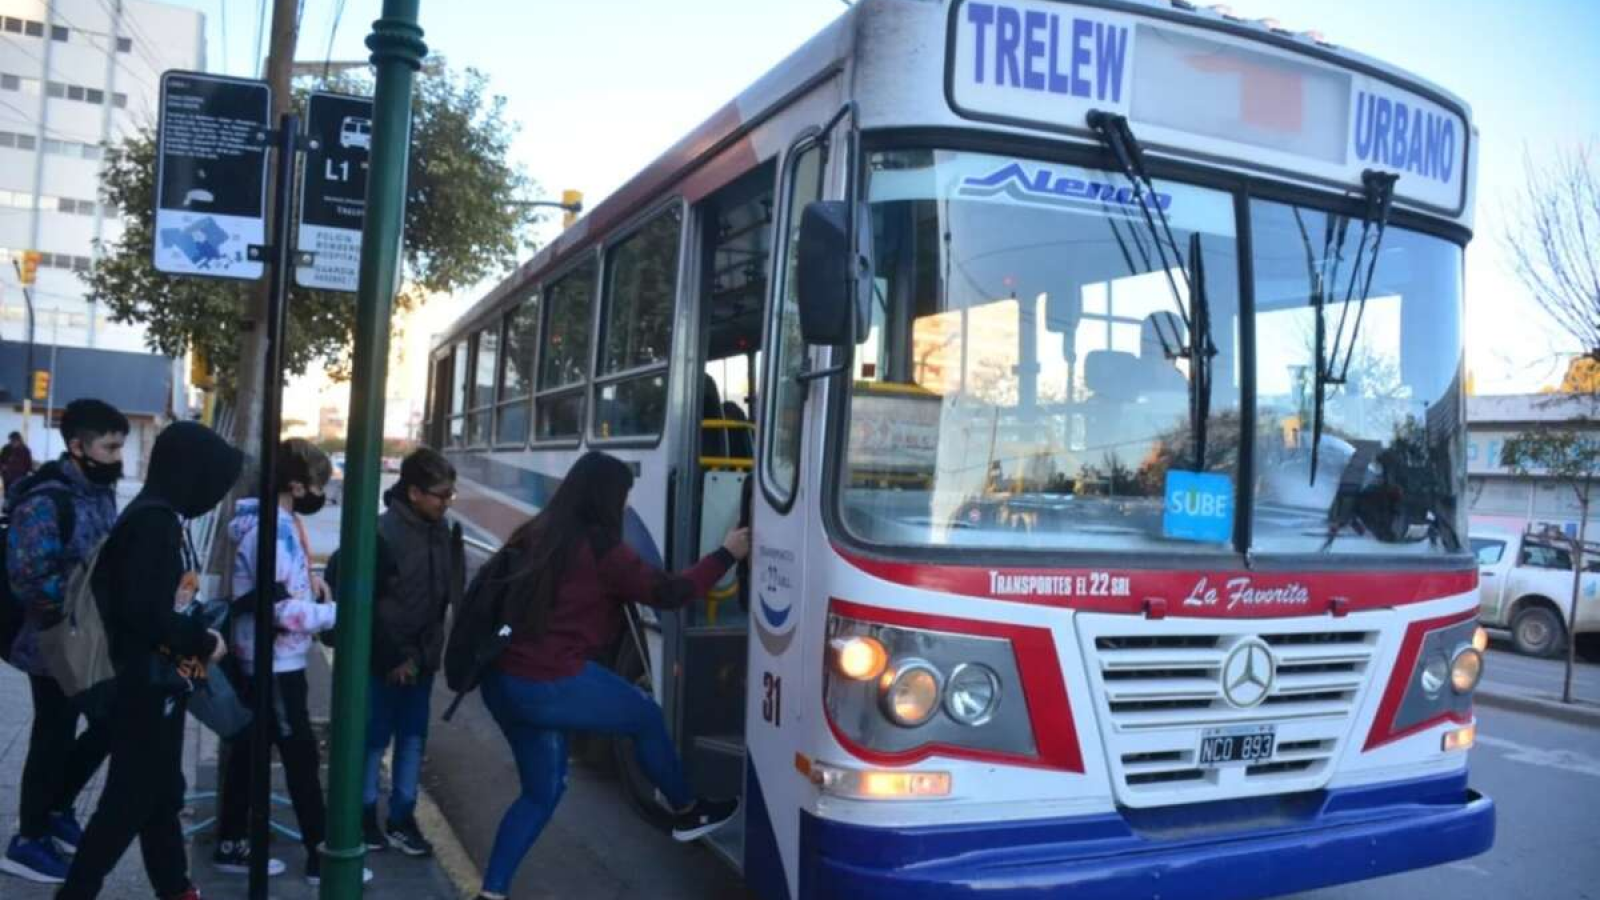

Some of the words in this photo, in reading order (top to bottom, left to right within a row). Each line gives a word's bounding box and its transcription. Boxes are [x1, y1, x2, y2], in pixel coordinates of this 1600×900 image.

[967, 3, 1128, 103] TRELEW
[1355, 91, 1453, 184] URBANO
[325, 158, 349, 181] L1
[1171, 489, 1227, 518] SUBE
[989, 570, 1072, 597] TRANSPORTES
[1076, 575, 1088, 597] EL
[1090, 571, 1110, 597] 22
[1183, 576, 1219, 606] La
[1226, 576, 1309, 610] Favorita
[762, 670, 782, 728] 31
[1202, 738, 1233, 761] NCO
[1242, 734, 1272, 759] 893
